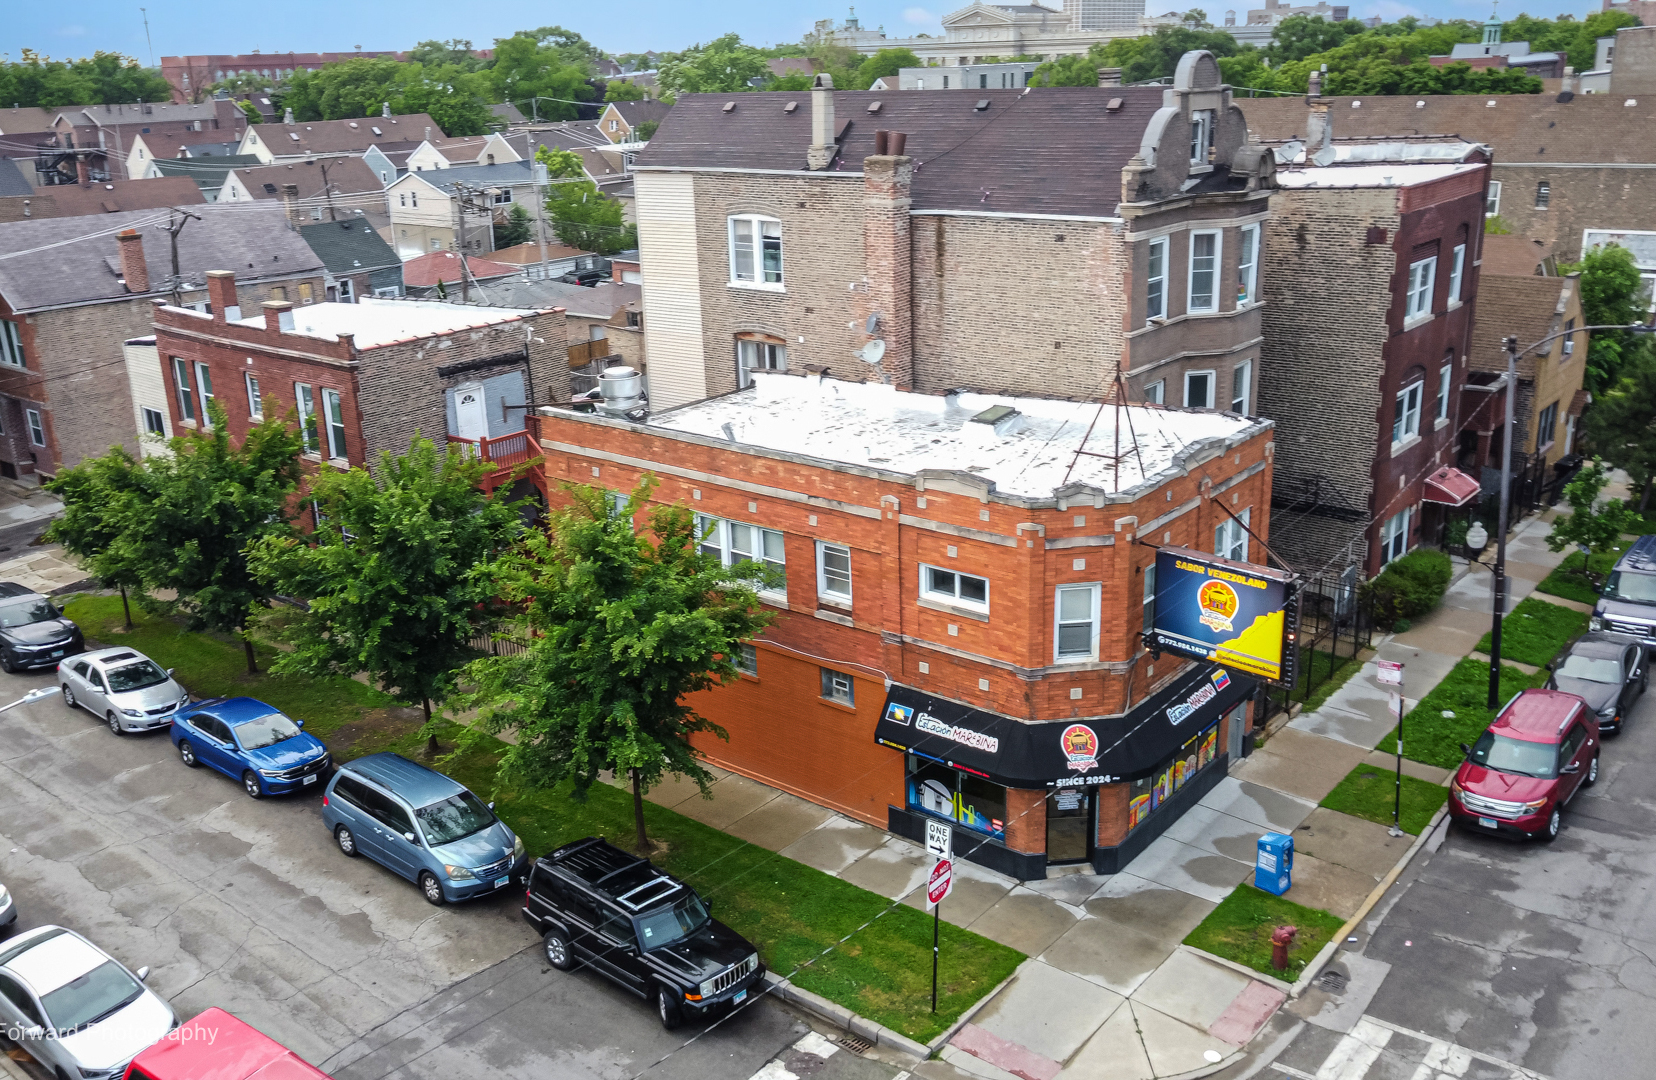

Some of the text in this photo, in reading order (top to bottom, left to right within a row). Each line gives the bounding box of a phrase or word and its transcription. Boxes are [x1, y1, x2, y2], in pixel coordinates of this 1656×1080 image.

[1175, 560, 1268, 590] SABOR VENEZOLANO
[1056, 775, 1111, 787] SINCE 2024
[929, 824, 948, 837] ONE
[929, 832, 948, 846] WAY
[930, 862, 950, 882] DO NOT
[932, 882, 948, 899] ENTER
